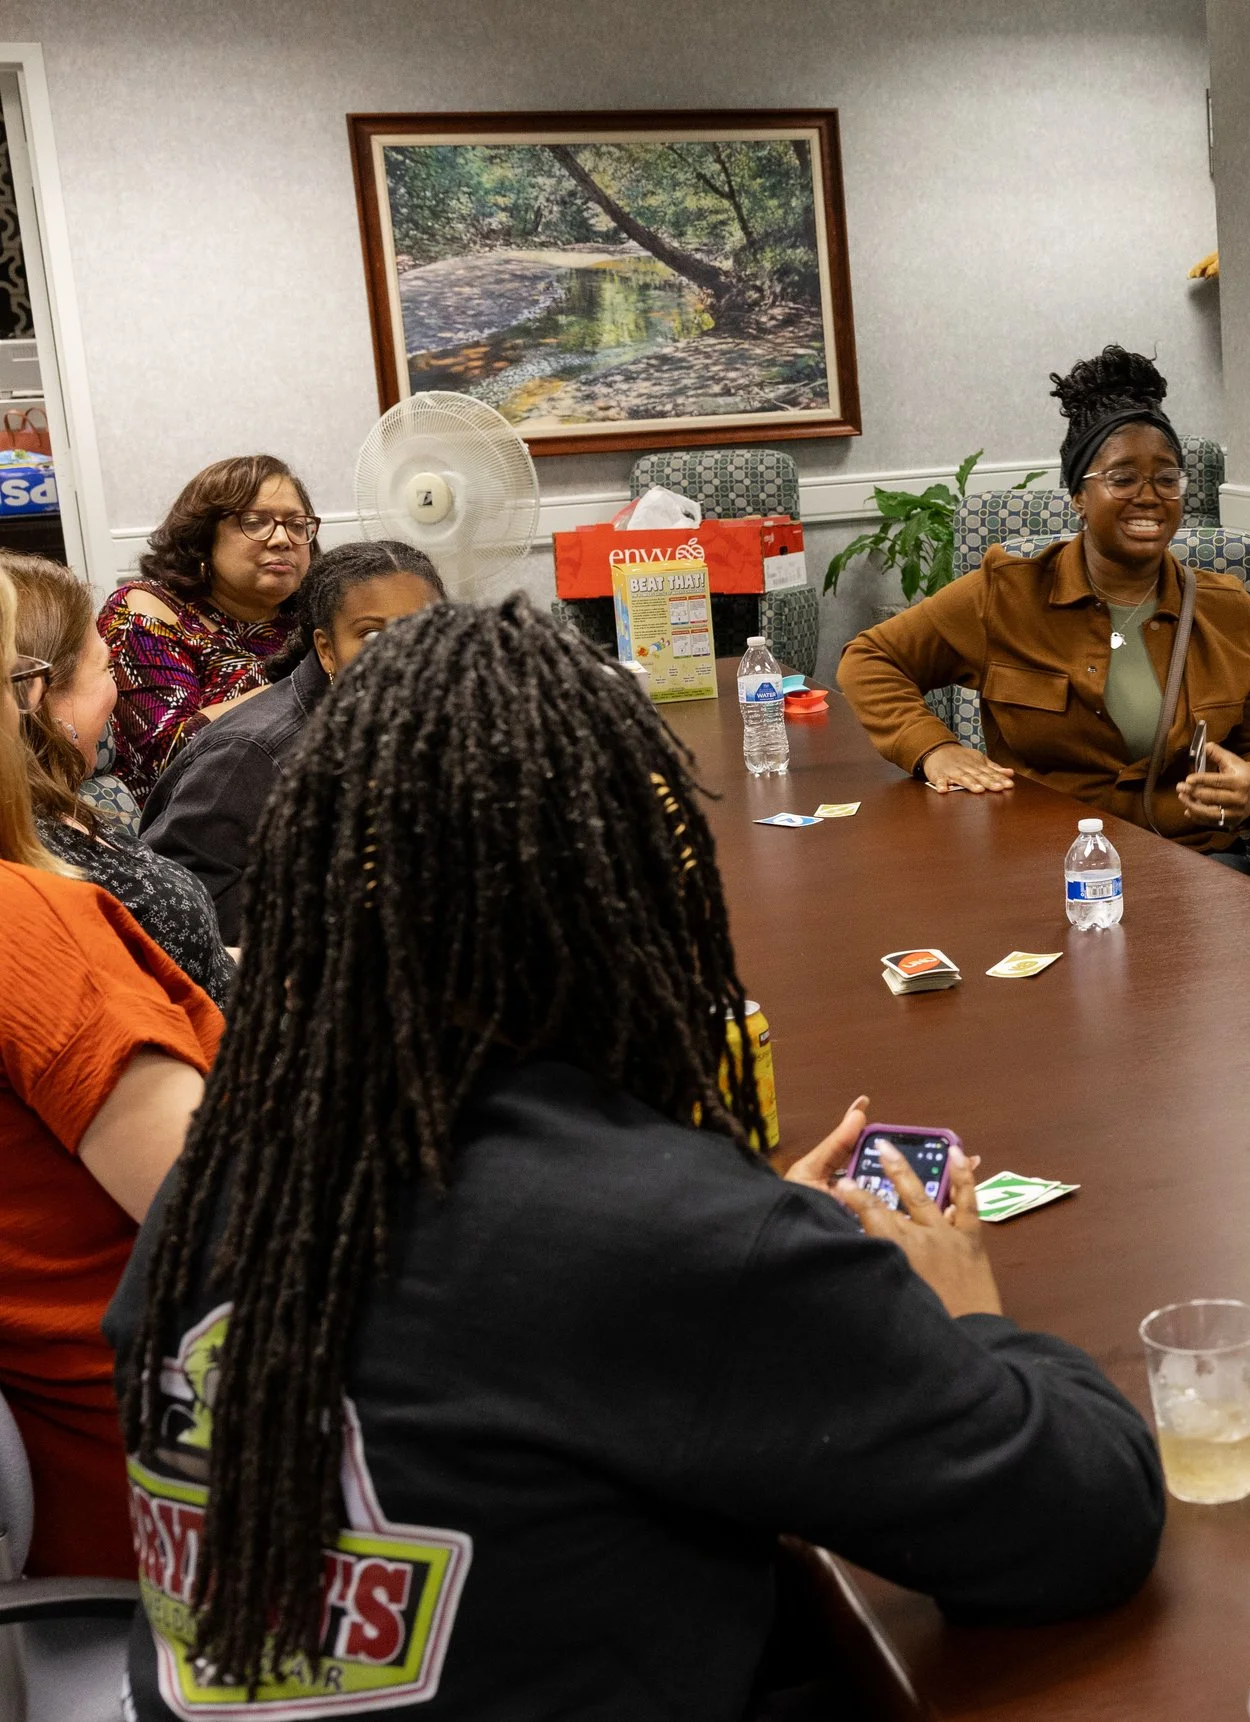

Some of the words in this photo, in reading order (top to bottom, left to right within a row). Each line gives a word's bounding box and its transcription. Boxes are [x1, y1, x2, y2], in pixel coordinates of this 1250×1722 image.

[630, 576, 665, 593] BEAT
[667, 573, 706, 591] THAT!
[901, 956, 937, 968] UNO
